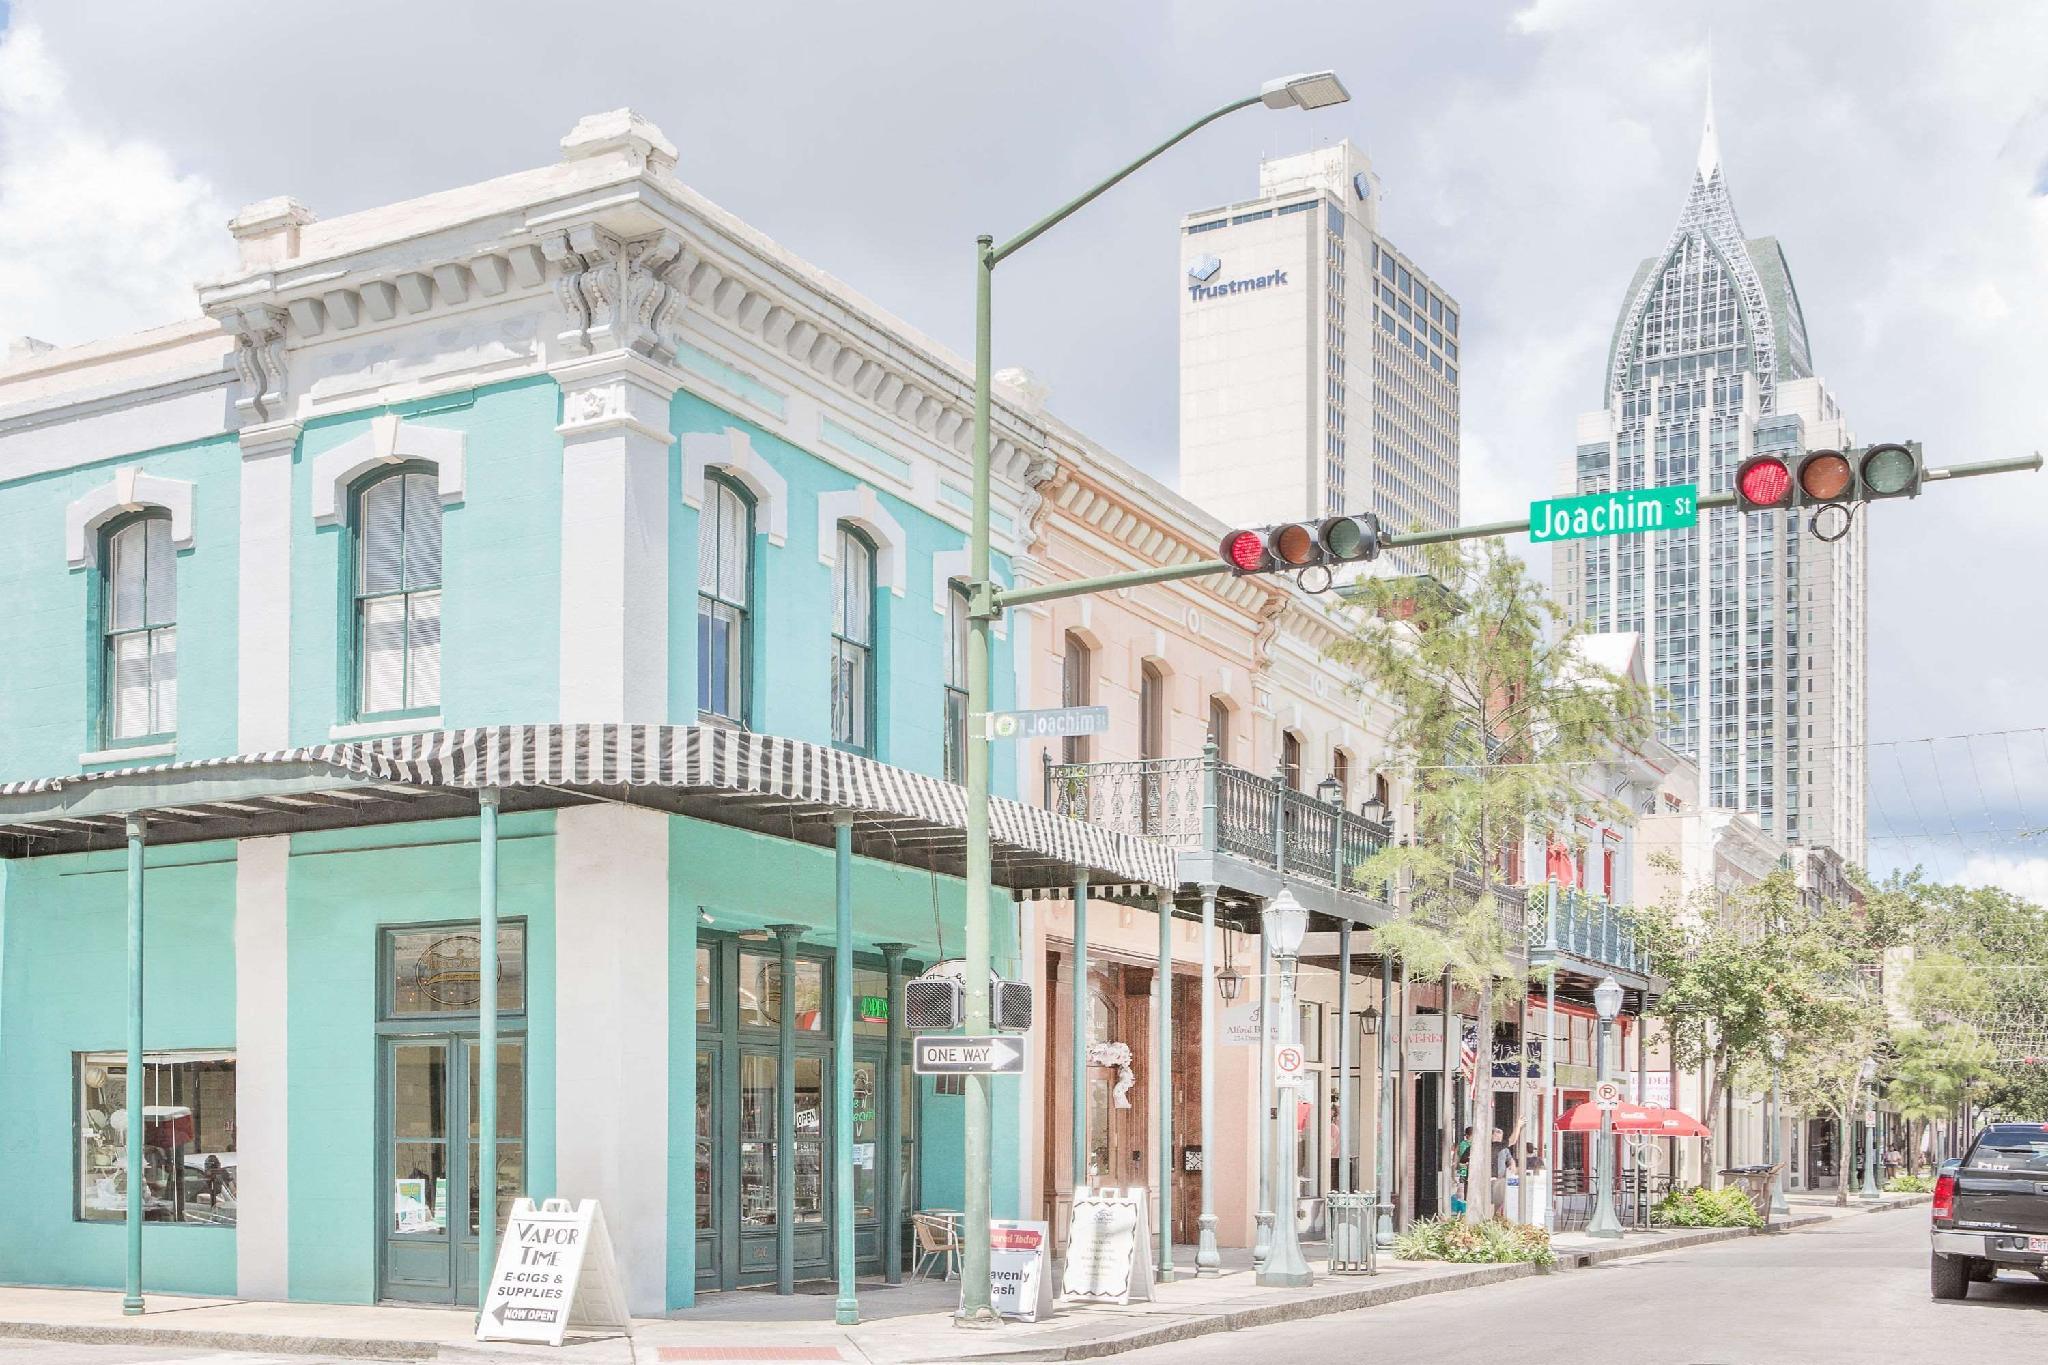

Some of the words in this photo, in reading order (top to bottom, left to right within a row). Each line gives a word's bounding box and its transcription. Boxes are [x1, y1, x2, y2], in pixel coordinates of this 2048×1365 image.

[1188, 269, 1288, 303] Trustmark
[1534, 495, 1663, 538] Joachim
[1674, 497, 1691, 516] St
[1027, 711, 1095, 734] Joachim
[927, 1047, 958, 1062] ONE
[963, 1047, 990, 1062] WAY
[797, 1112, 817, 1126] OPEN
[517, 1222, 579, 1245] VAPOR
[1014, 1233, 1039, 1247] Today
[521, 1245, 560, 1266] TIME
[504, 1272, 549, 1284] E-CIGS
[553, 1274, 563, 1284] &
[990, 1270, 1029, 1283] avenly
[497, 1286, 563, 1299] SUPPLIES
[991, 1284, 1015, 1295] ash
[504, 1308, 527, 1320] NOW
[527, 1309, 555, 1321] OPEN
